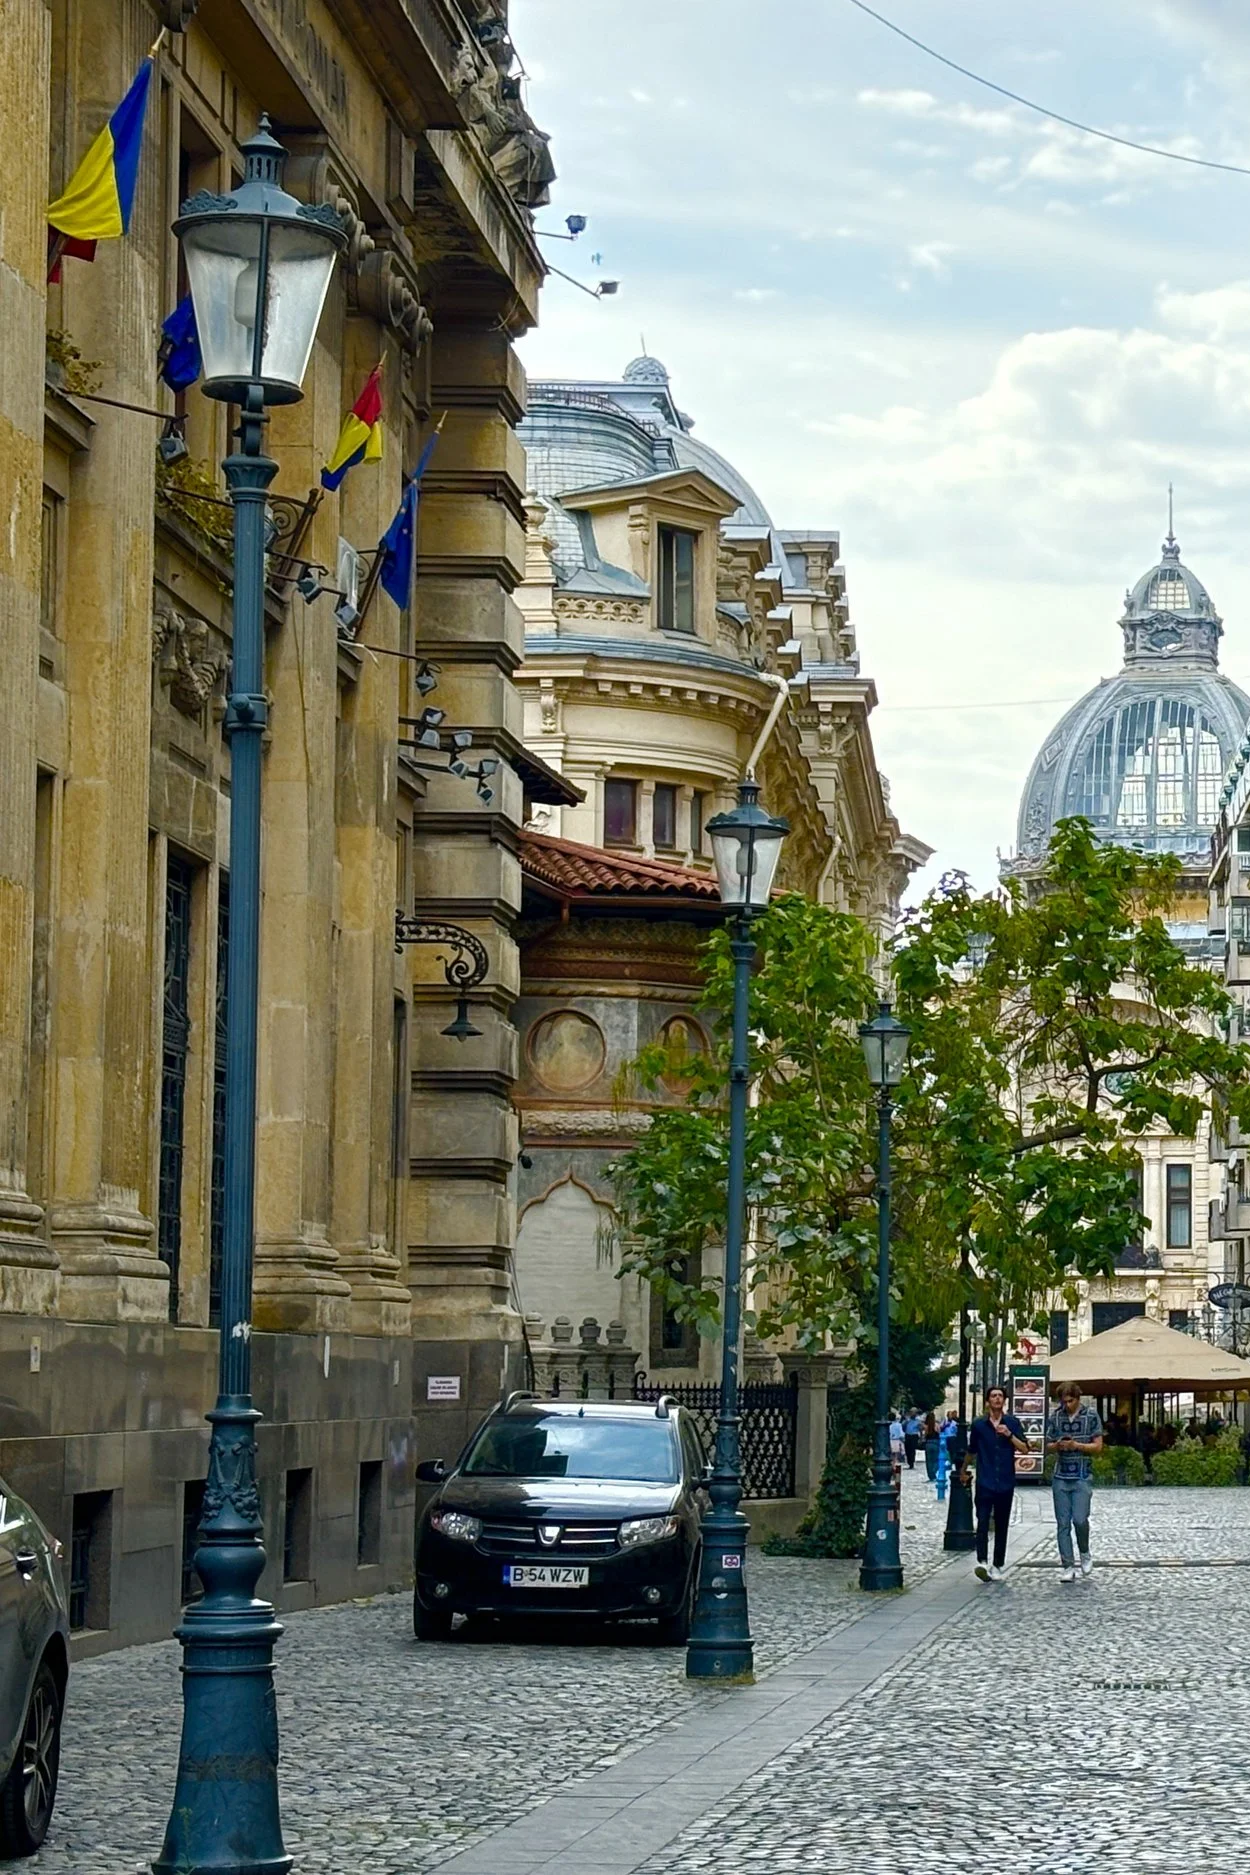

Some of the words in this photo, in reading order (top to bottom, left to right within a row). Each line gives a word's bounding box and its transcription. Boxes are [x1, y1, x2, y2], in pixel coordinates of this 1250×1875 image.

[513, 1567, 524, 1582] B
[528, 1567, 546, 1582] 54
[550, 1568, 585, 1583] WZW
